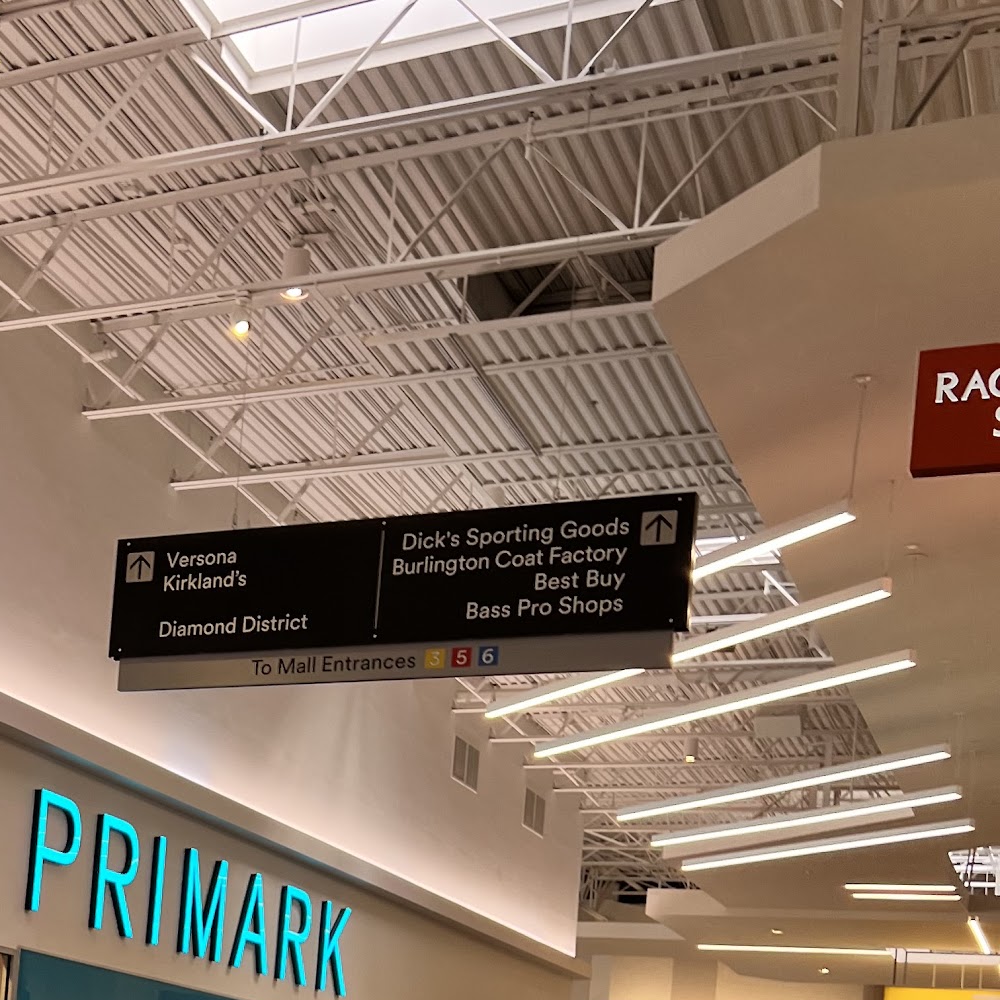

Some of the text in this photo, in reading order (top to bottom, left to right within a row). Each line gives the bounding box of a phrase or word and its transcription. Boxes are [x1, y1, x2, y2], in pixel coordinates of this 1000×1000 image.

[402, 517, 631, 551] Dick's Sporting Goods
[166, 551, 238, 569] Versona
[392, 546, 628, 577] Burlington Coat Factory
[163, 570, 248, 592] Kirkland's
[534, 569, 626, 591] Best Buy
[466, 596, 624, 621] Bass Pro Shops
[158, 613, 309, 638] Diamond District
[251, 648, 494, 676] To Mall Entrances 3 5 6
[25, 787, 353, 998] PRIMARK
